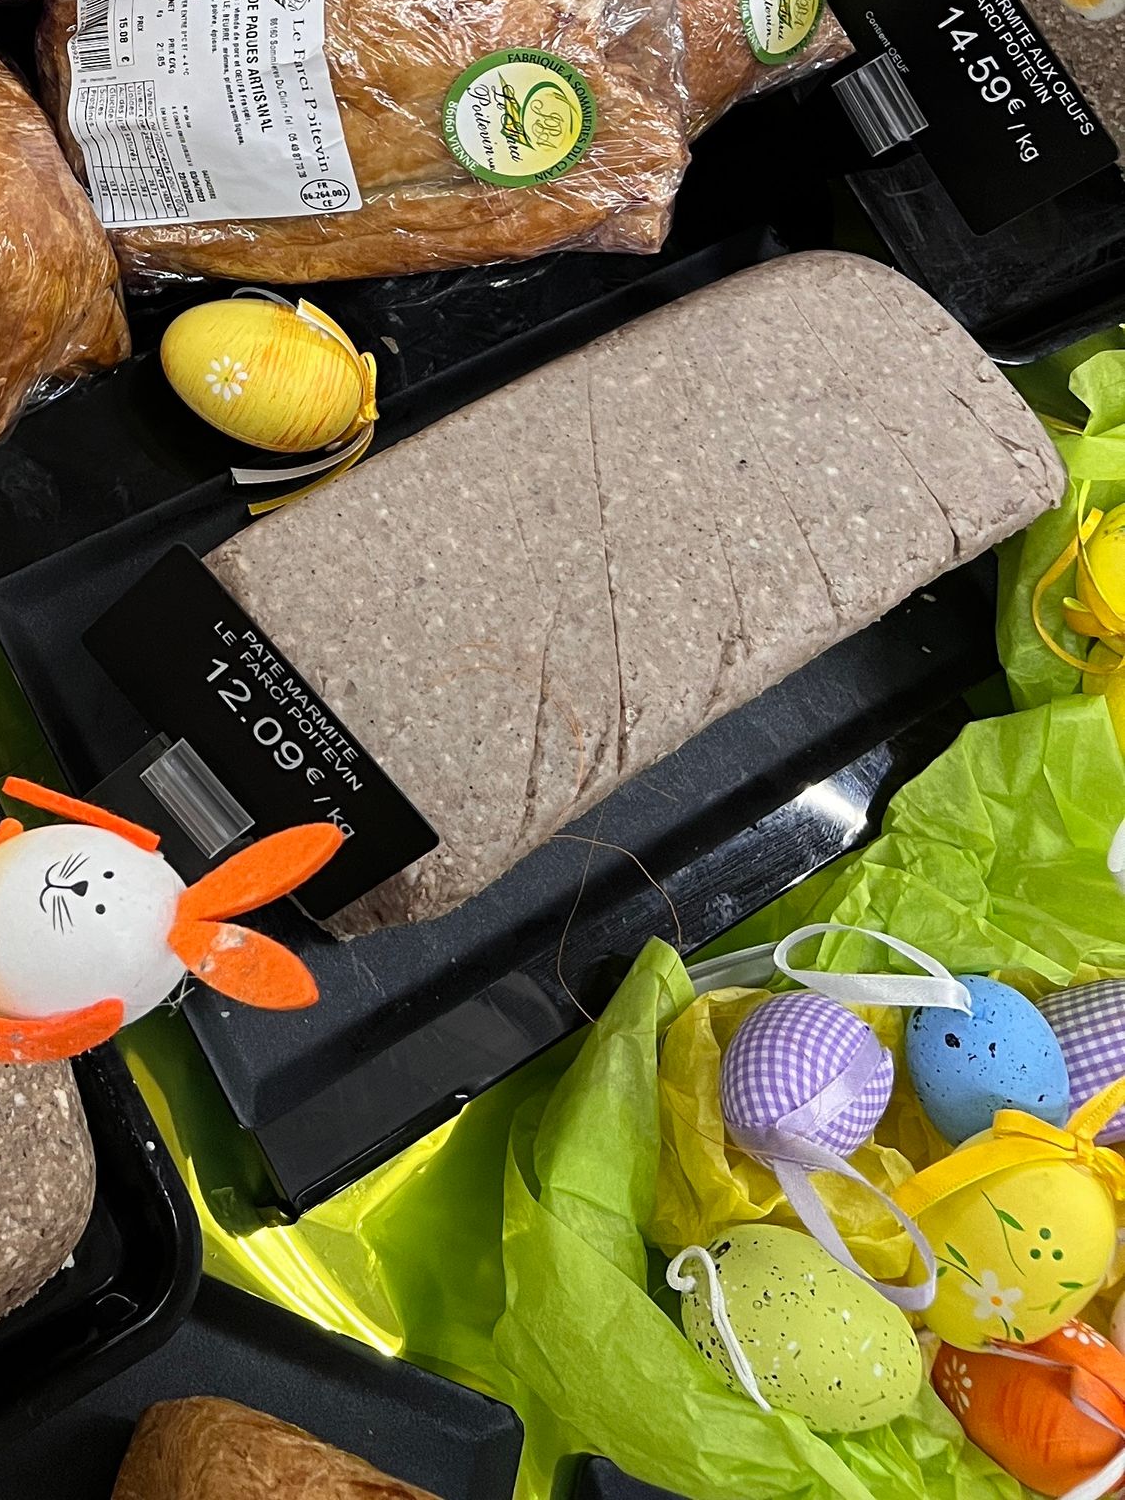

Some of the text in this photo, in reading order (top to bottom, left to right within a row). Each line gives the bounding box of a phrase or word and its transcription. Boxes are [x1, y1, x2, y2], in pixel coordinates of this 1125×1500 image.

[117, 16, 130, 63] 15.08 €
[135, 14, 144, 32] PRIX
[166, 36, 175, 55] PRIX
[232, 41, 241, 58] porc
[233, 31, 240, 41] de
[245, 14, 259, 64] PAQUES
[862, 9, 910, 76] Contient OEUF
[233, 59, 241, 67] et
[274, 78, 285, 90] Du
[936, 1, 1041, 164] 14.59€ / kg
[997, 30, 1052, 105] POITEVIN
[1027, 43, 1058, 81] AUX
[1049, 77, 1095, 137] OEUFS
[246, 66, 274, 133] ARTISANAL
[291, 17, 330, 173] Le Farci Poitevin
[467, 83, 494, 157] Poitevin
[493, 83, 524, 161] Le Farci
[506, 55, 592, 181] FABRIQUE SOMMIERES DU CLAIN
[289, 142, 300, 152] 49
[292, 151, 303, 162] 87
[443, 101, 478, 172] 86160 VIENNE
[302, 187, 349, 201] 86.264.001
[316, 180, 328, 189] FR
[321, 198, 333, 208] CE
[212, 620, 363, 792] LE FARCI POITEVIN
[241, 628, 359, 764] PATE MARMITE
[205, 654, 326, 787] 12.09€
[312, 790, 331, 808] /
